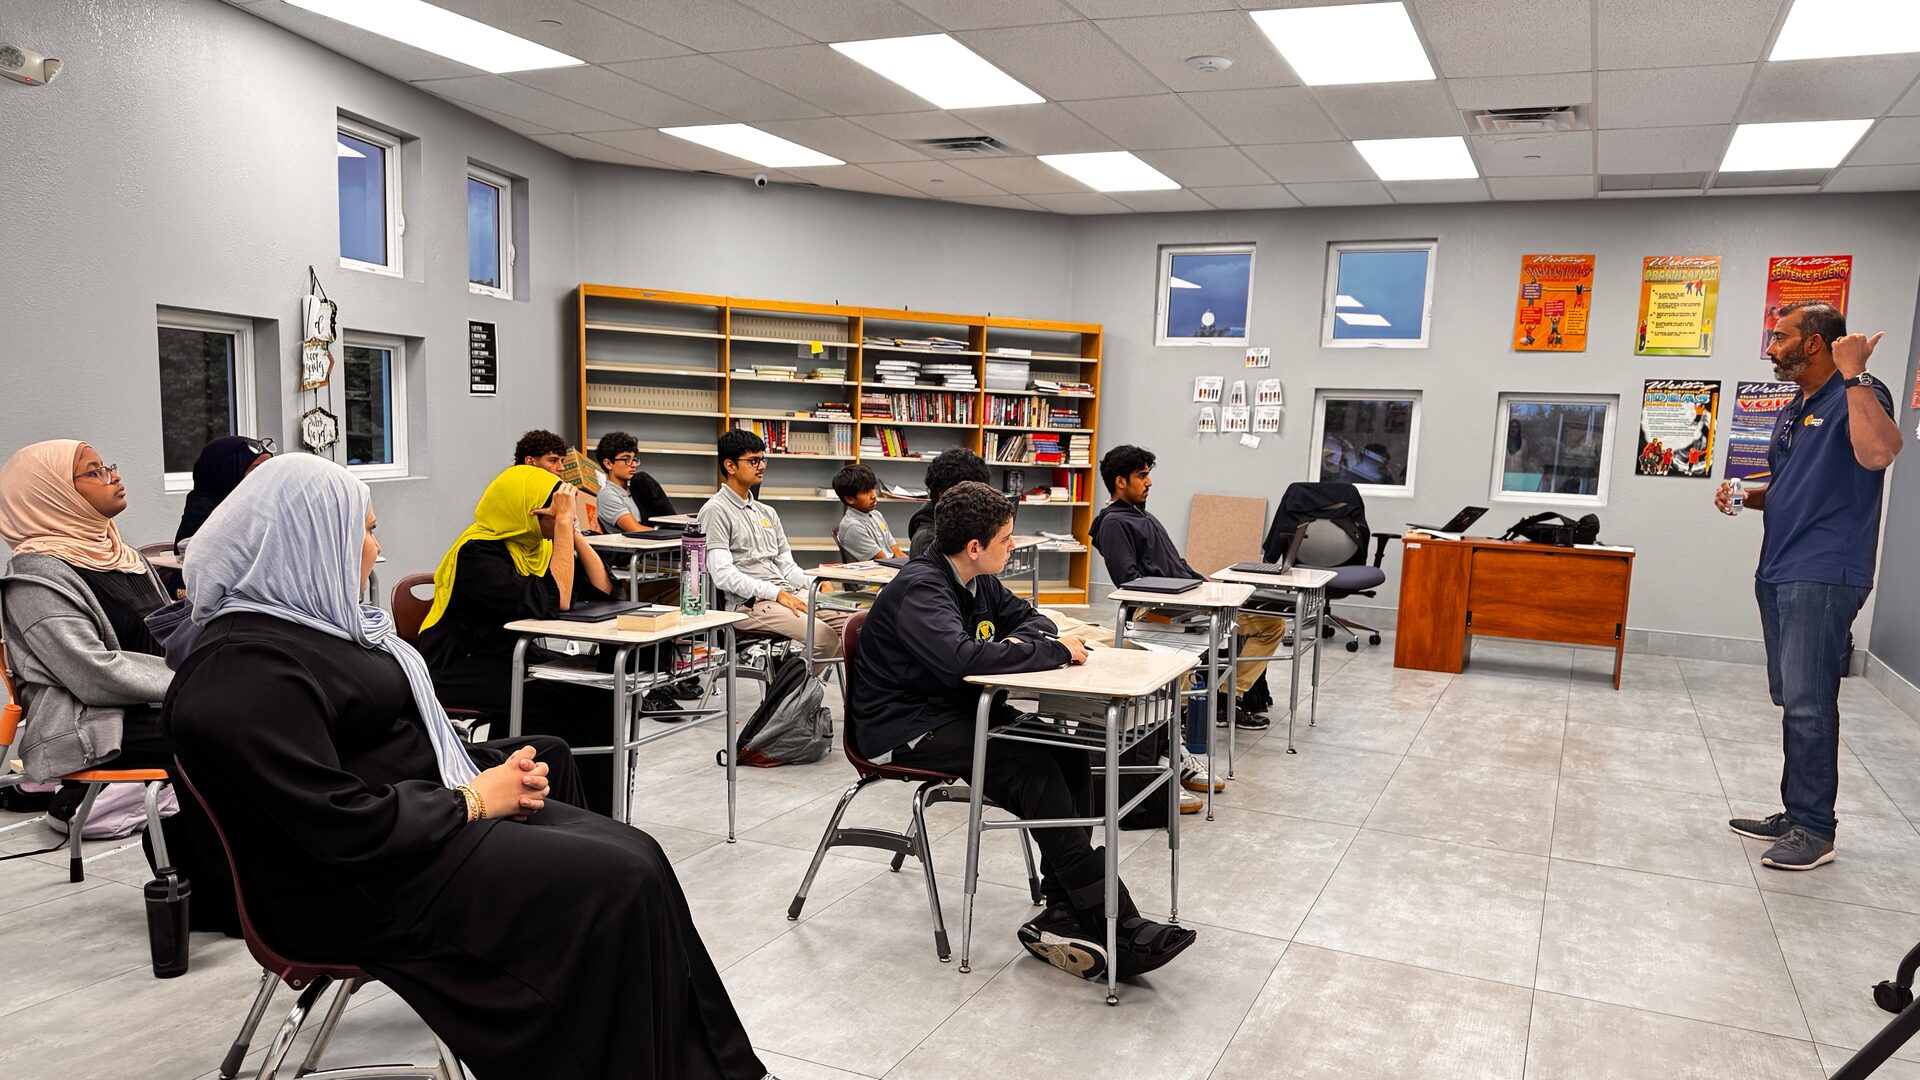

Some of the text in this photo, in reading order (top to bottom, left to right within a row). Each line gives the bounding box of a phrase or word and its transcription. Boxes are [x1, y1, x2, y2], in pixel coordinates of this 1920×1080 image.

[1646, 256, 1717, 268] Writing
[1773, 257, 1848, 267] Writing
[1645, 269, 1718, 280] ORGANIZATION
[1771, 268, 1811, 282] SENTENCE
[1813, 266, 1850, 281] FLUENCY
[1646, 380, 1720, 392] Writing
[1645, 392, 1711, 404] IDEAS
